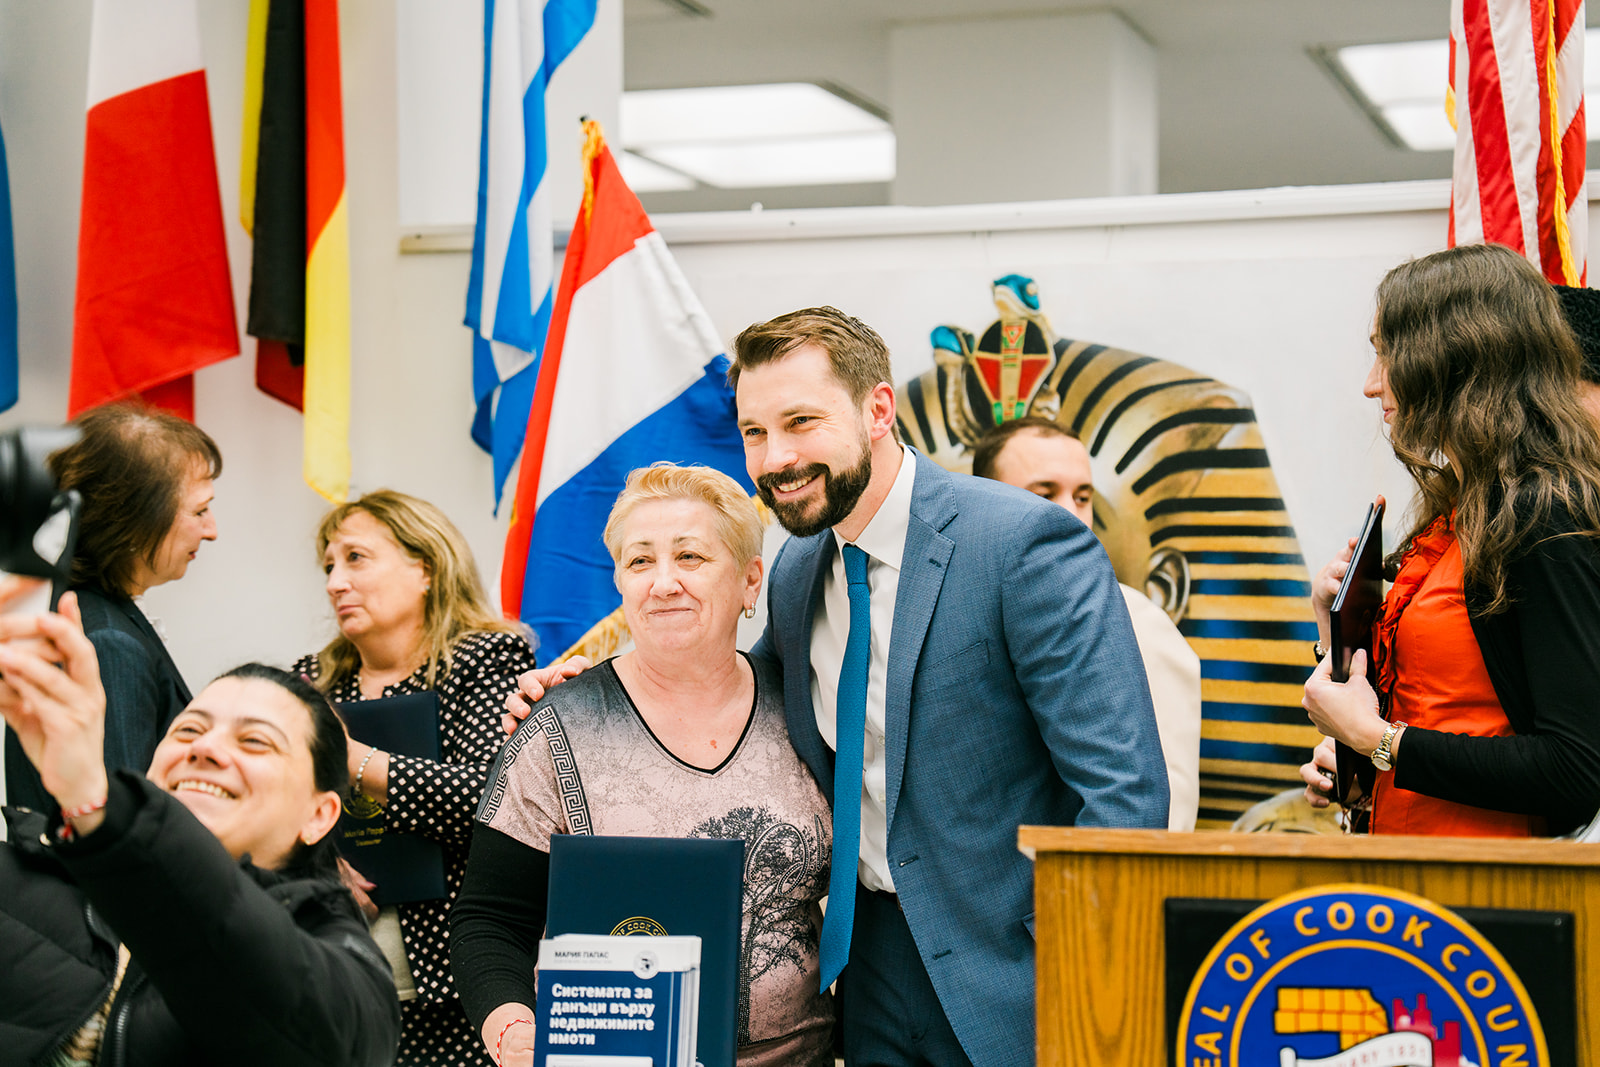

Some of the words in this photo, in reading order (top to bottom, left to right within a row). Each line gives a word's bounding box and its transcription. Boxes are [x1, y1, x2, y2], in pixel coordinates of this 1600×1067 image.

[627, 922, 651, 931] COOK
[1225, 928, 1271, 981] OF
[1294, 901, 1432, 948] COOK
[551, 983, 631, 999] Системата
[634, 987, 653, 999] за
[550, 1001, 607, 1016] данъци
[609, 1003, 655, 1018] върху
[549, 1017, 655, 1032] недвижимите
[548, 1032, 596, 1045] имоти
